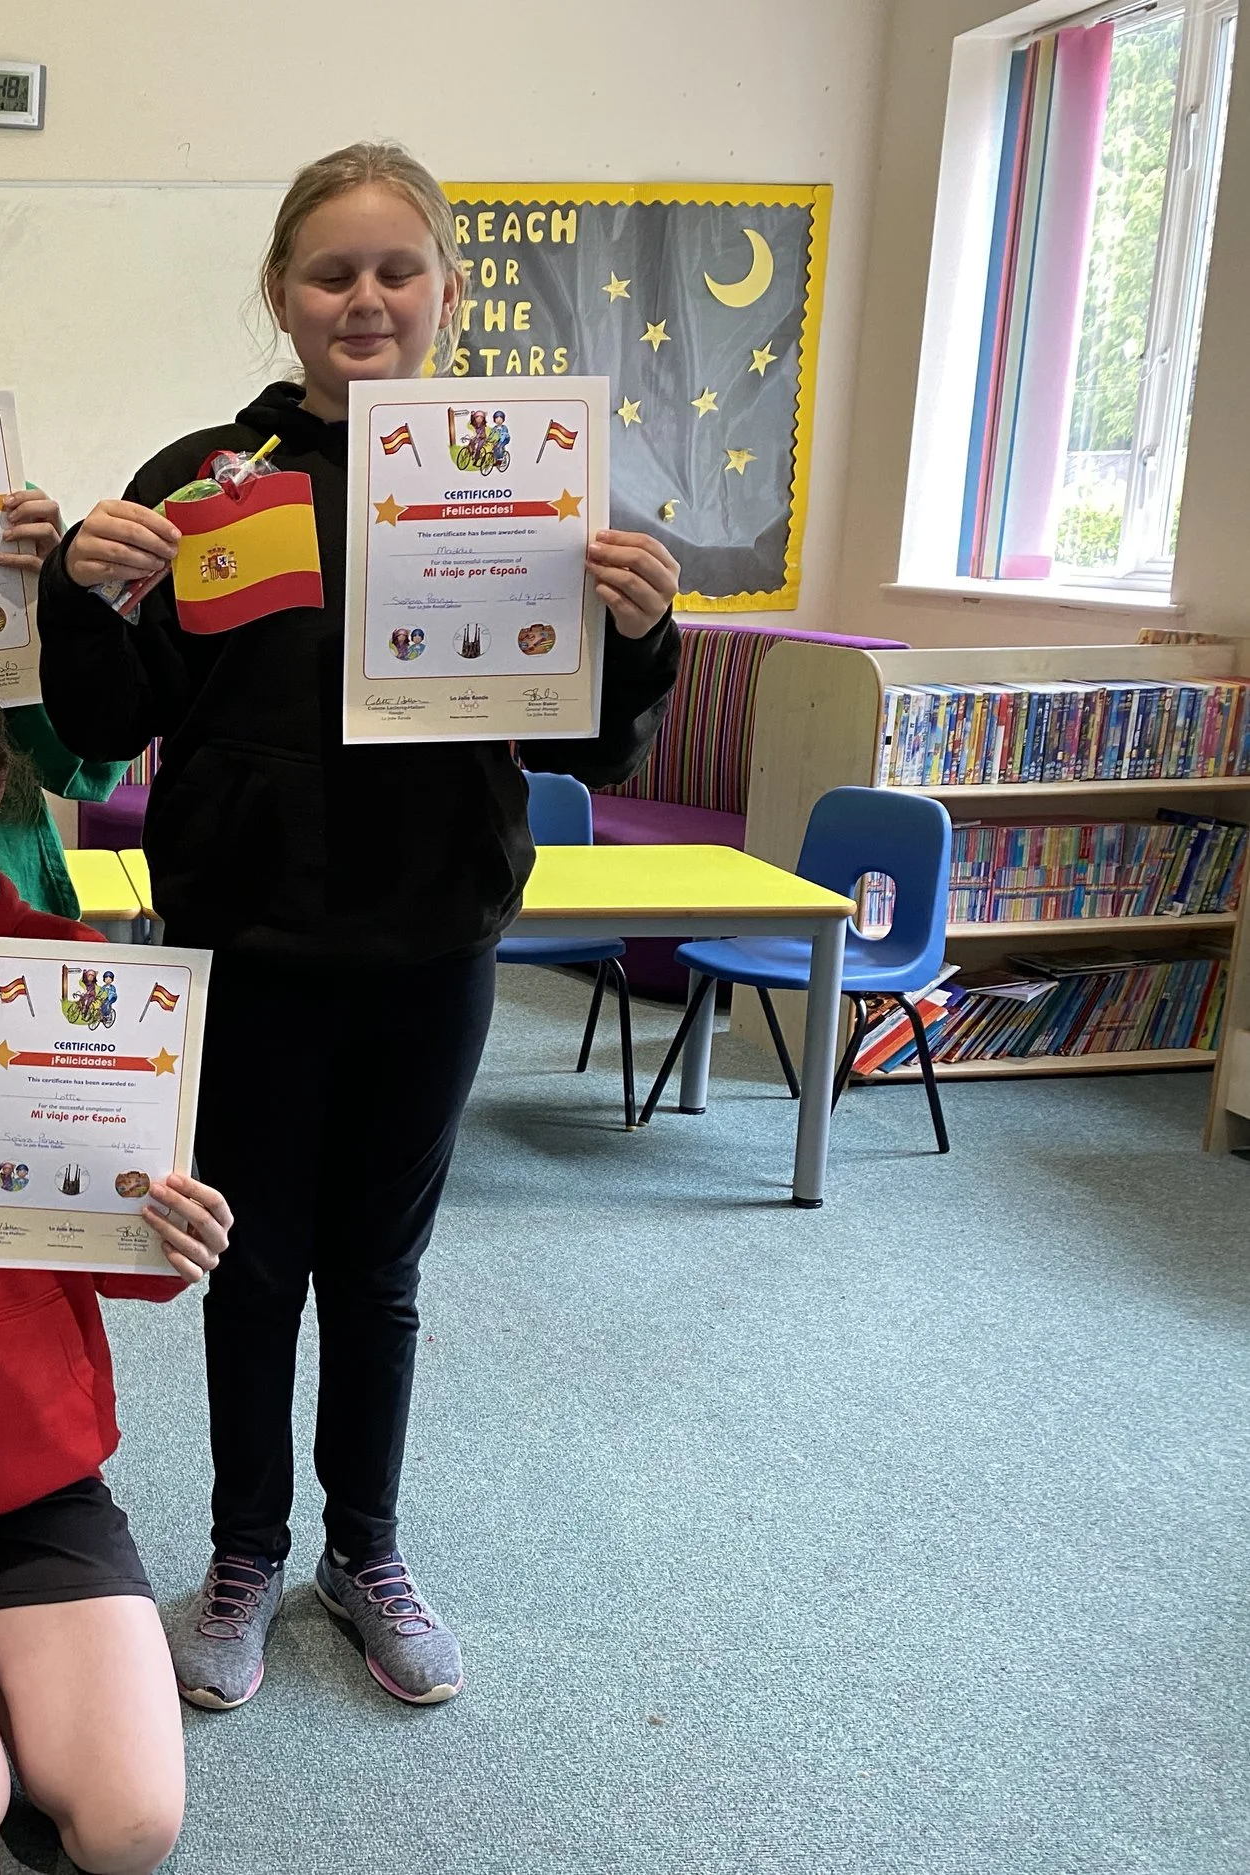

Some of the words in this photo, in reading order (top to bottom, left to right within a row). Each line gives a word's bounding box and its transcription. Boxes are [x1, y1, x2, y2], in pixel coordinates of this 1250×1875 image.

[454, 209, 577, 244] REACH
[461, 299, 532, 333] THE
[452, 346, 568, 376] STARS
[444, 488, 511, 499] CERTIFICADO
[441, 503, 513, 517] ¡Felicidades!
[423, 567, 436, 577] Mi
[440, 567, 464, 578] viaje
[468, 568, 485, 577] por
[489, 564, 527, 576] España
[54, 1041, 115, 1052] CERTIFICADO
[51, 1055, 116, 1066] ¡Felicidades!
[30, 1109, 43, 1119] Mi
[46, 1110, 68, 1122] viaje
[72, 1114, 88, 1123] por
[91, 1113, 126, 1125] España
